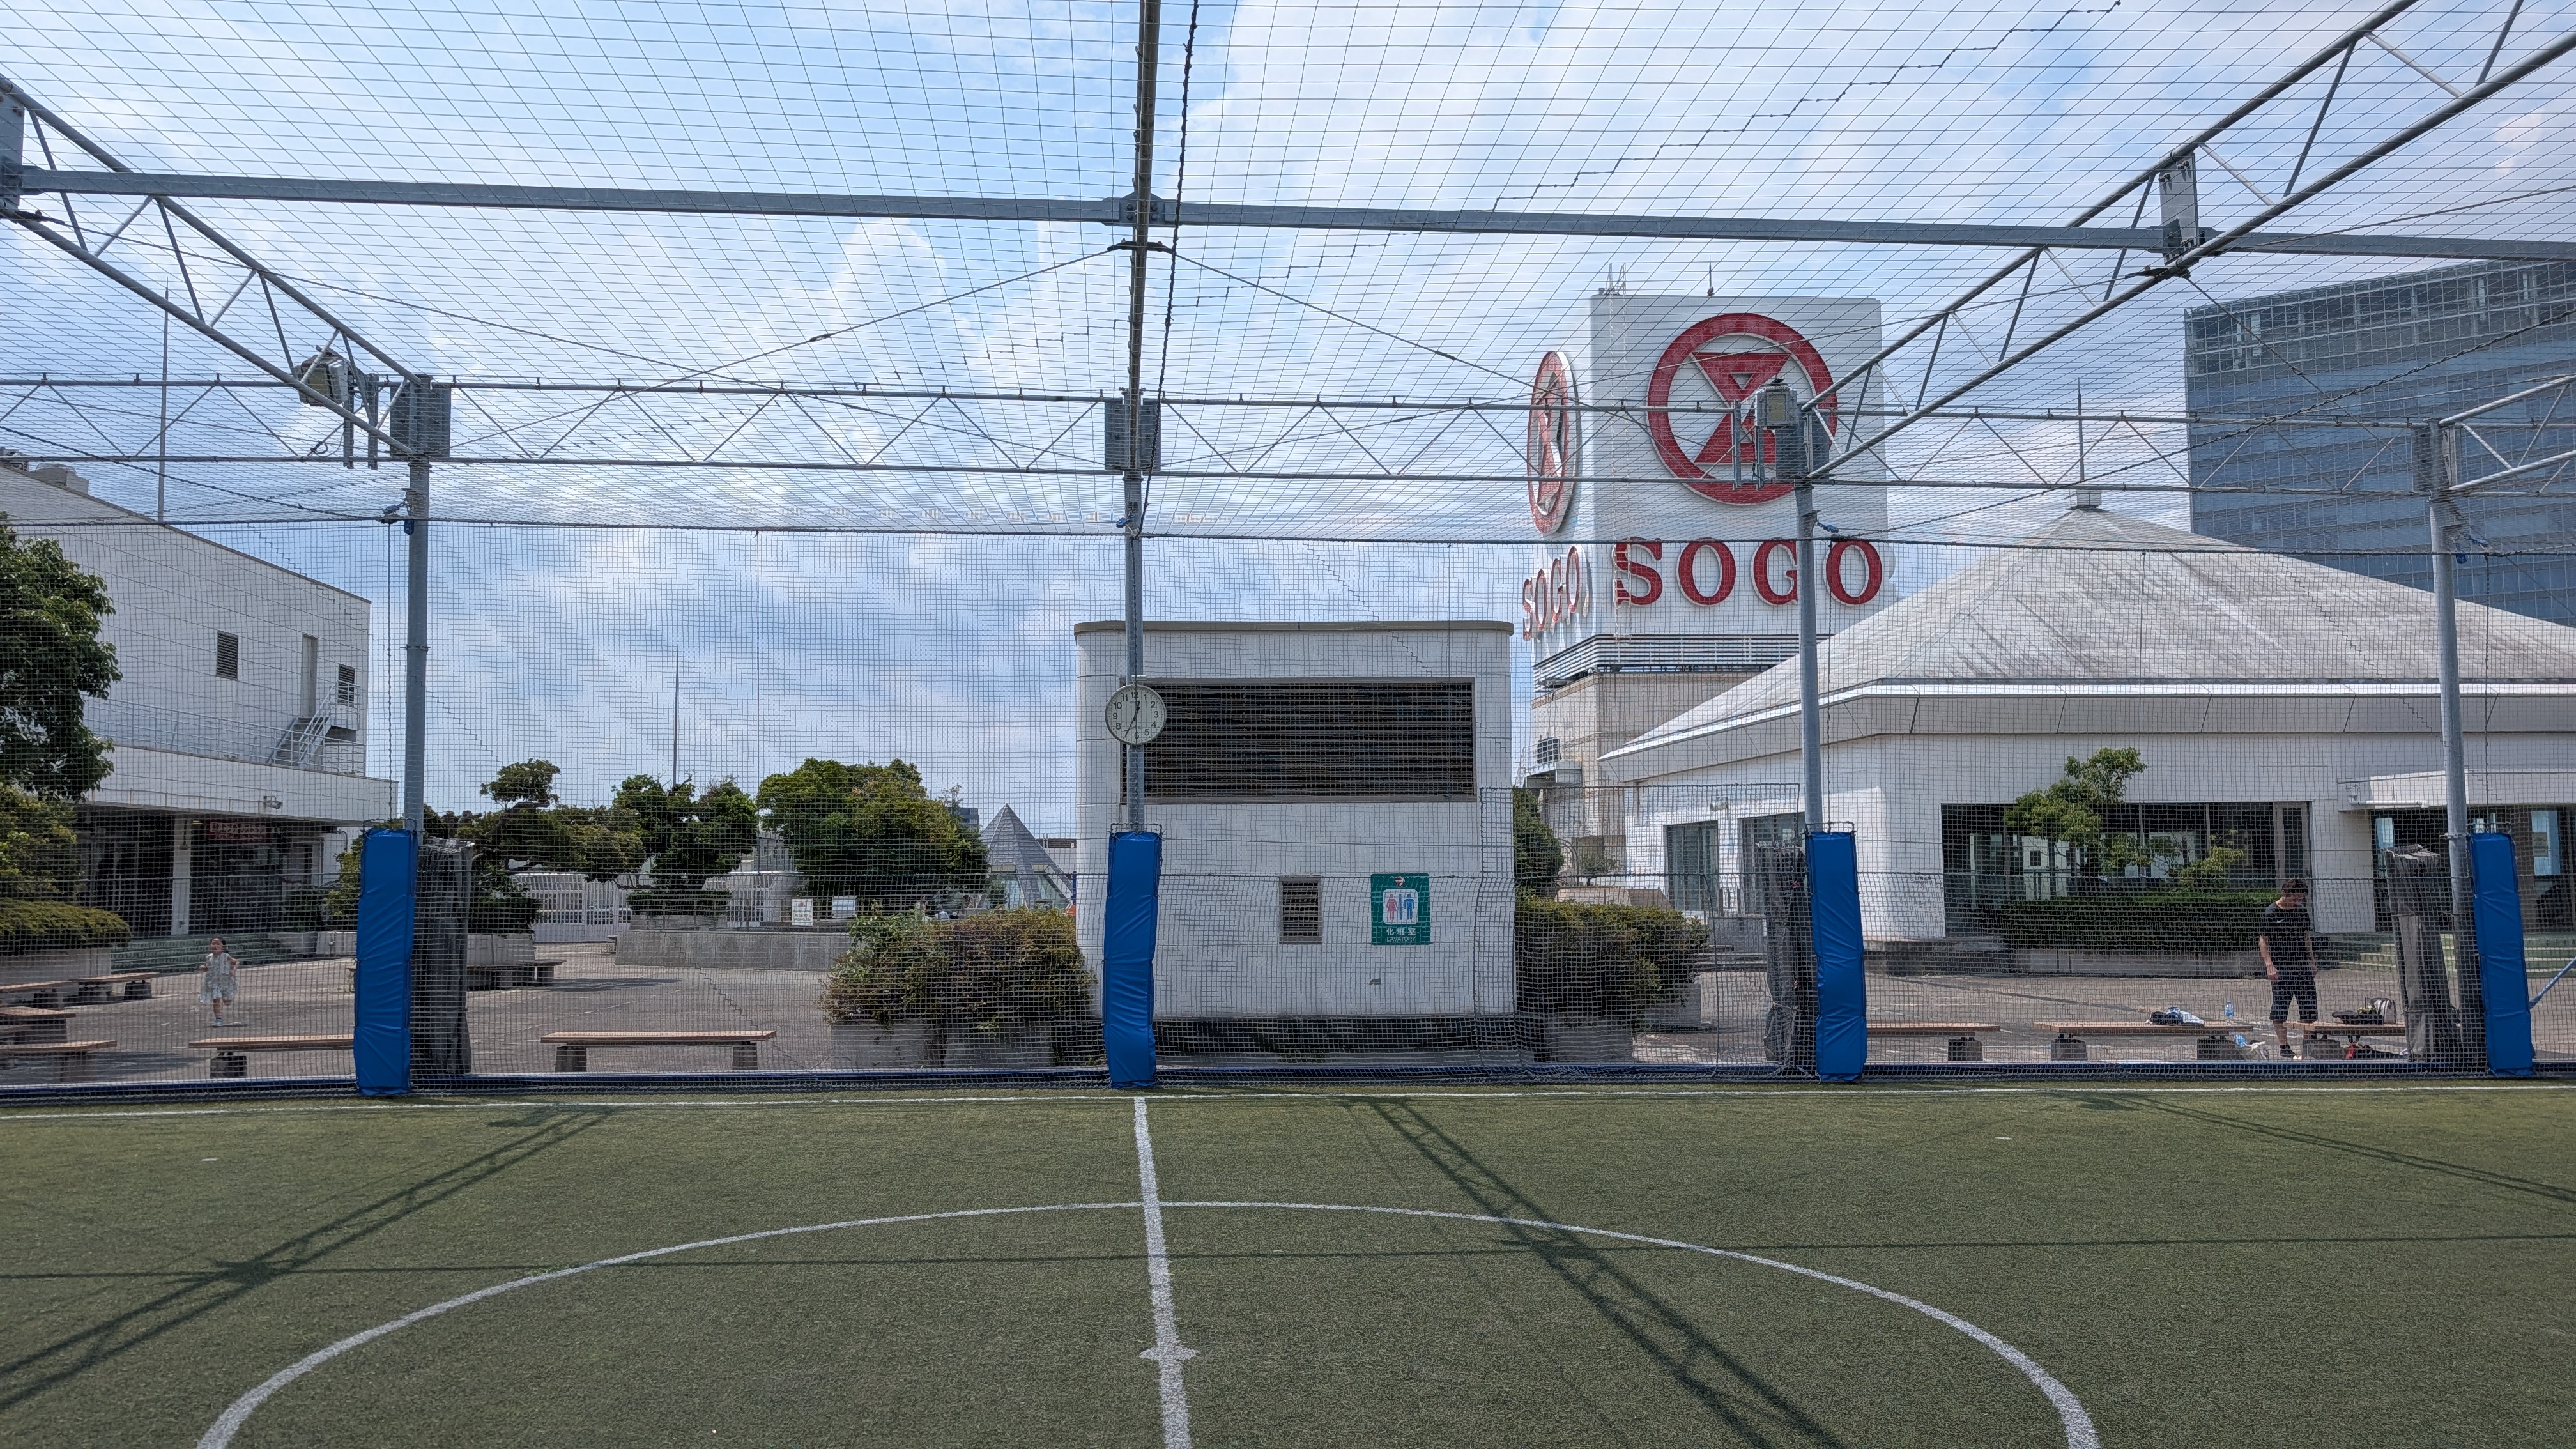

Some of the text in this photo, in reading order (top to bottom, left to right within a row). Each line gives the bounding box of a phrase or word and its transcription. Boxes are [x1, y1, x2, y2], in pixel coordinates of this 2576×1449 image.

[1522, 546, 1580, 641] SOGO
[1614, 537, 1883, 606] SOGO
[1386, 928, 1416, 936] 化粧室
